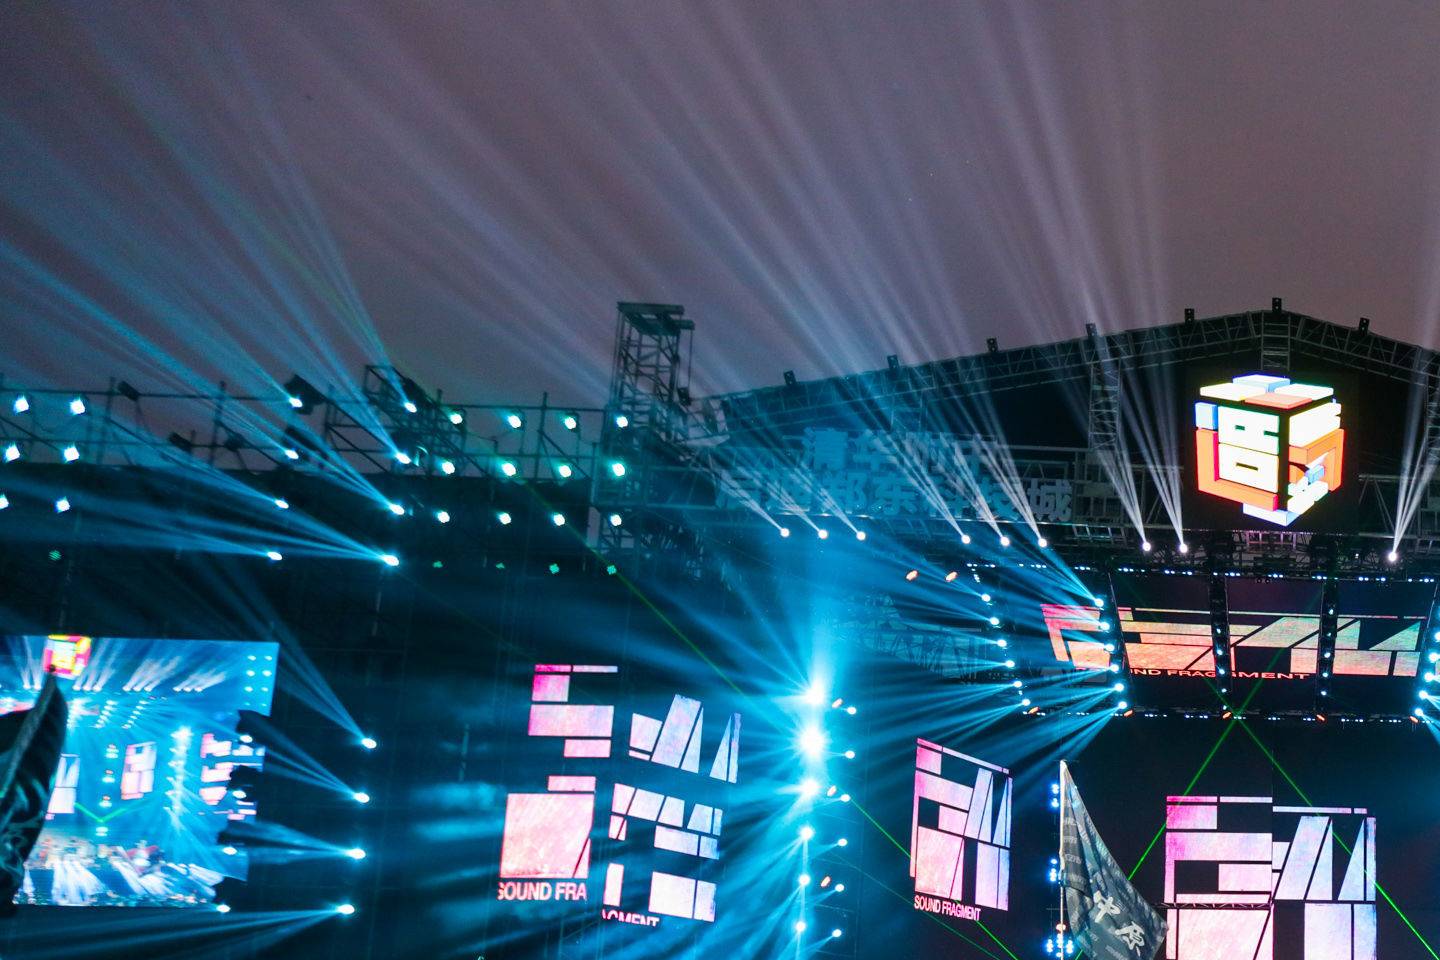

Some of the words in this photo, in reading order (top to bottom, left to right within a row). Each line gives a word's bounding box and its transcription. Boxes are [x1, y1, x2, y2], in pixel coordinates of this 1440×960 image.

[497, 881, 553, 901] SOUND
[914, 895, 941, 913] SOUND
[942, 901, 981, 920] FRAGMENT
